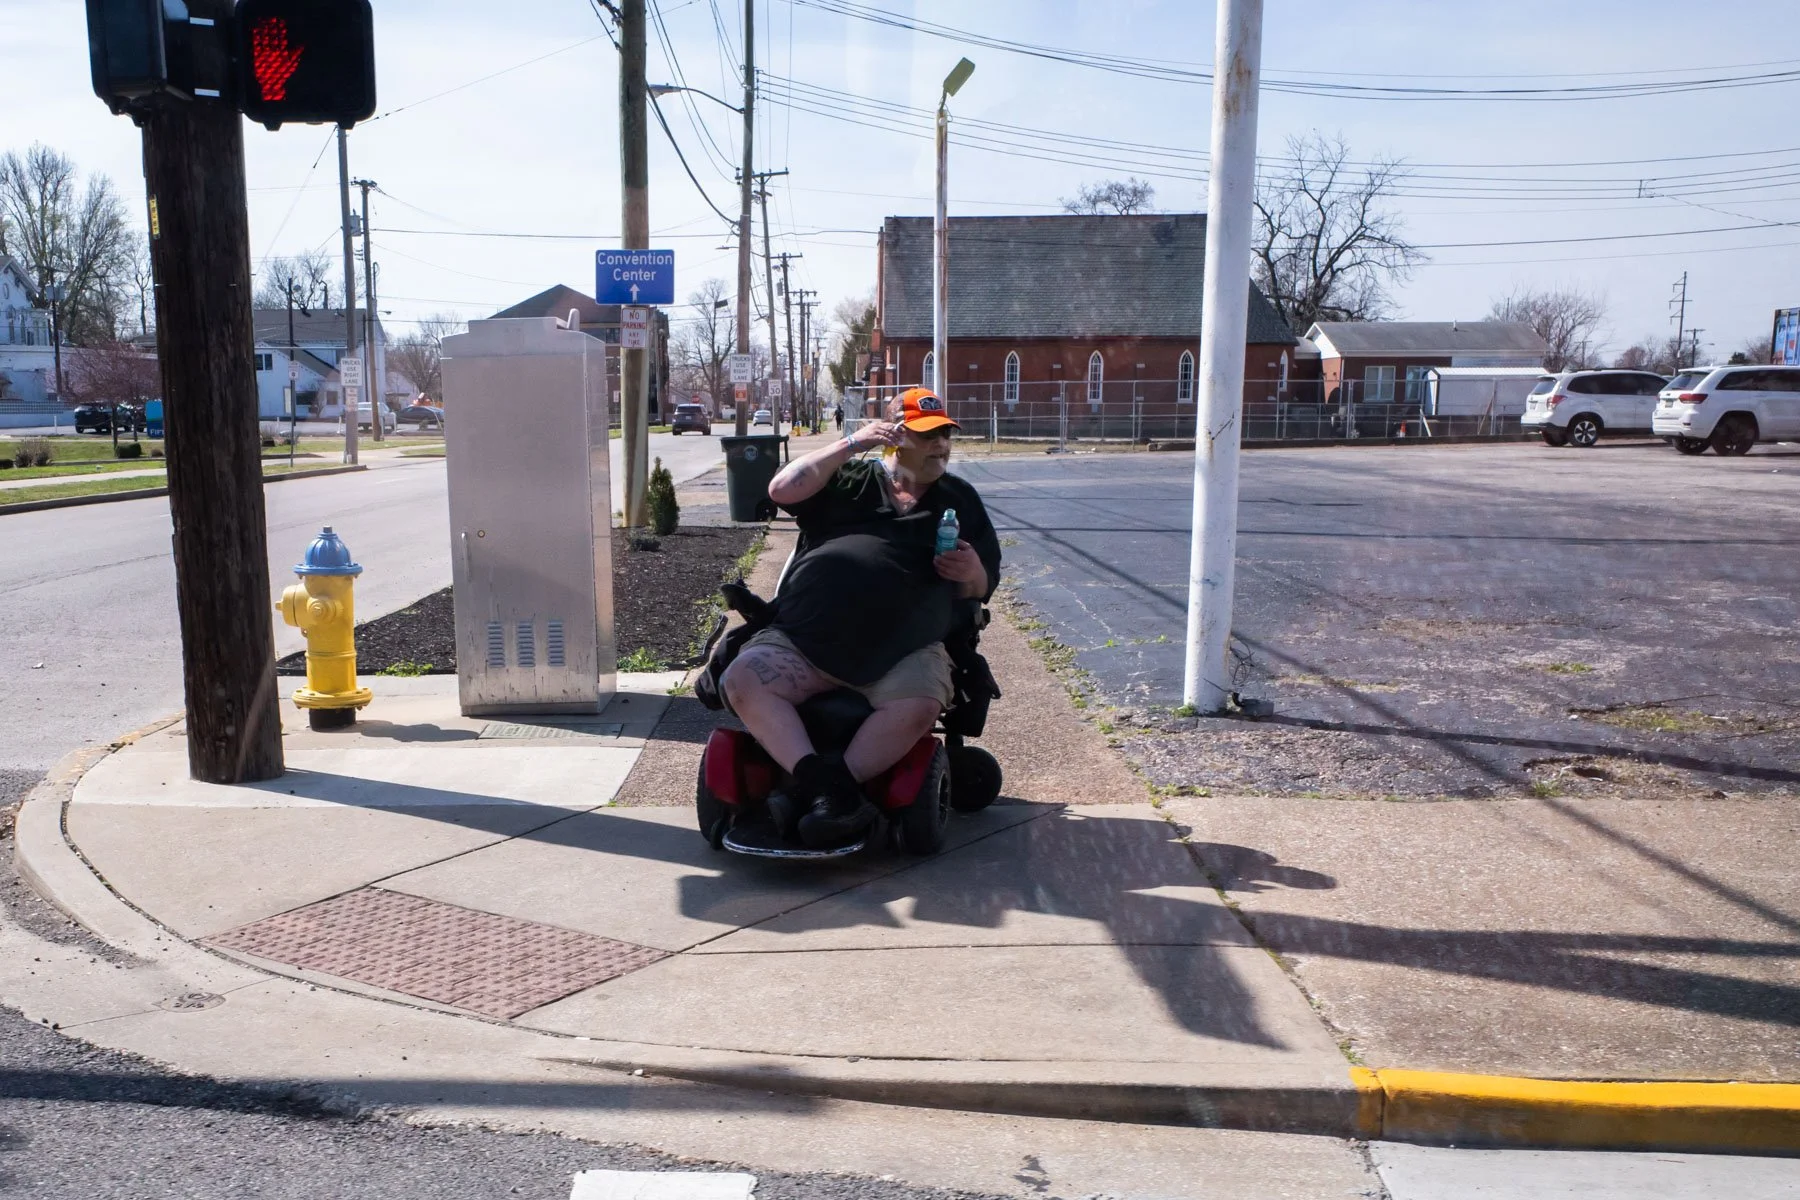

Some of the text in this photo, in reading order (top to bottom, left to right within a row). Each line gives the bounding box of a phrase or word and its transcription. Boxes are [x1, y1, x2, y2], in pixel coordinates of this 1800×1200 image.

[598, 252, 673, 265] Convention
[613, 268, 657, 281] Center
[770, 387, 780, 395] 30
